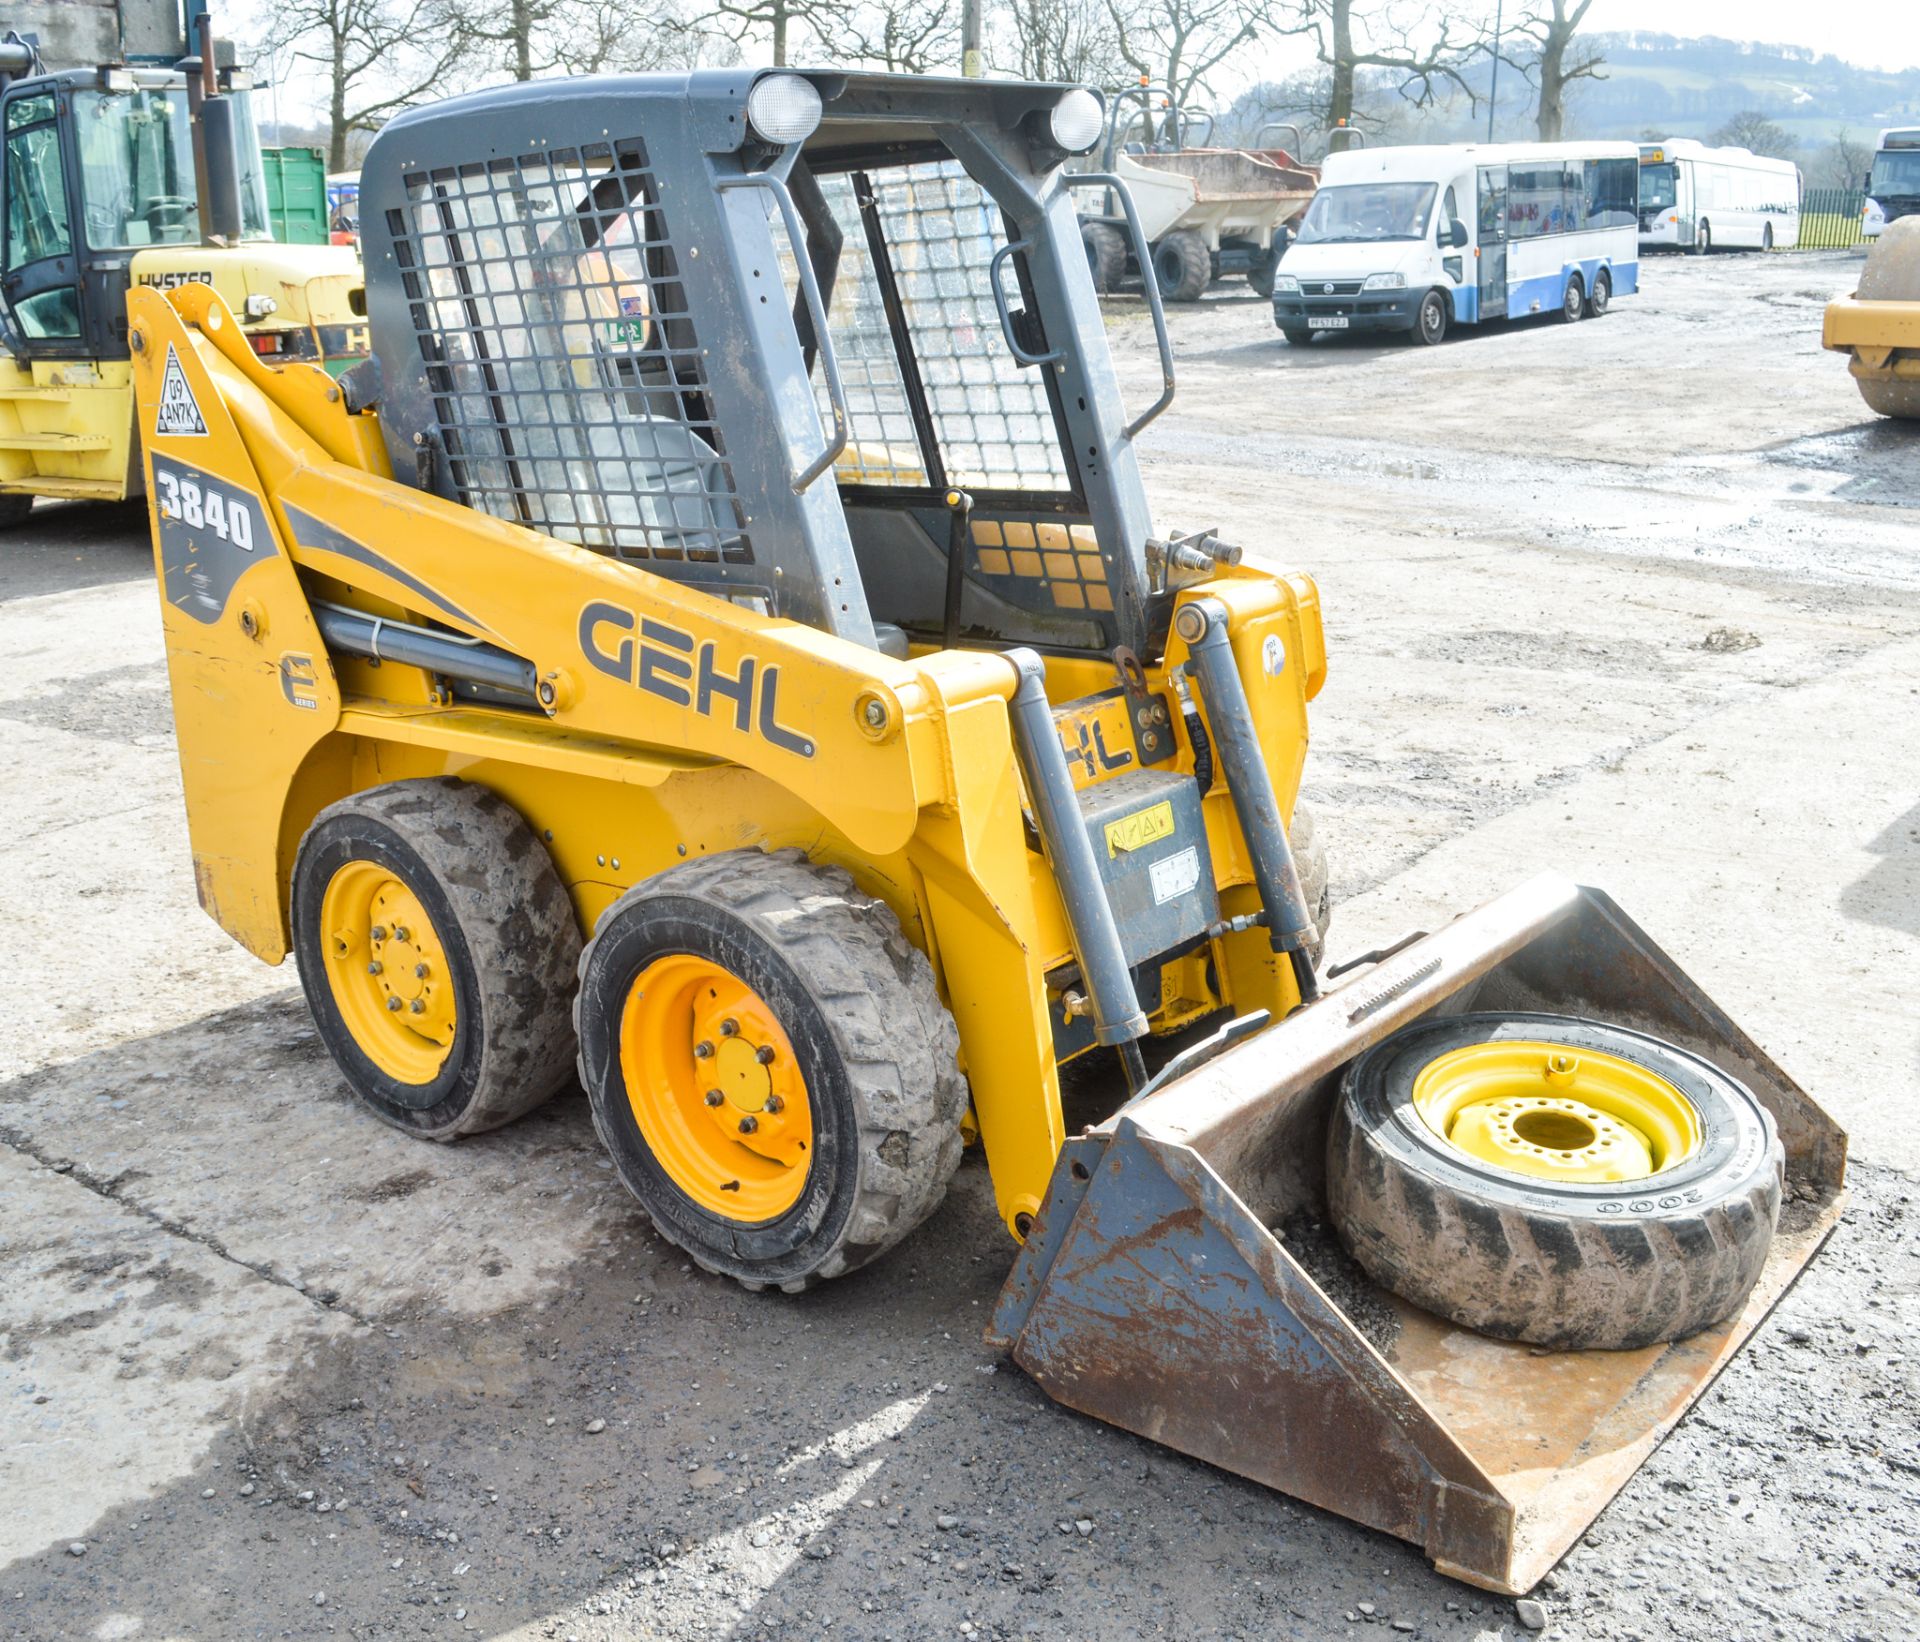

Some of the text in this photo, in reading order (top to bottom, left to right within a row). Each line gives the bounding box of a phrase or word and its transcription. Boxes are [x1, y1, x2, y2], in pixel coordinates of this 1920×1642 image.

[138, 271, 212, 290] HYSTER
[169, 379, 183, 400] 09
[166, 402, 194, 424] AN7K
[158, 470, 254, 551] 3840
[578, 601, 816, 759] GEHL
[1058, 719, 1132, 777] HL
